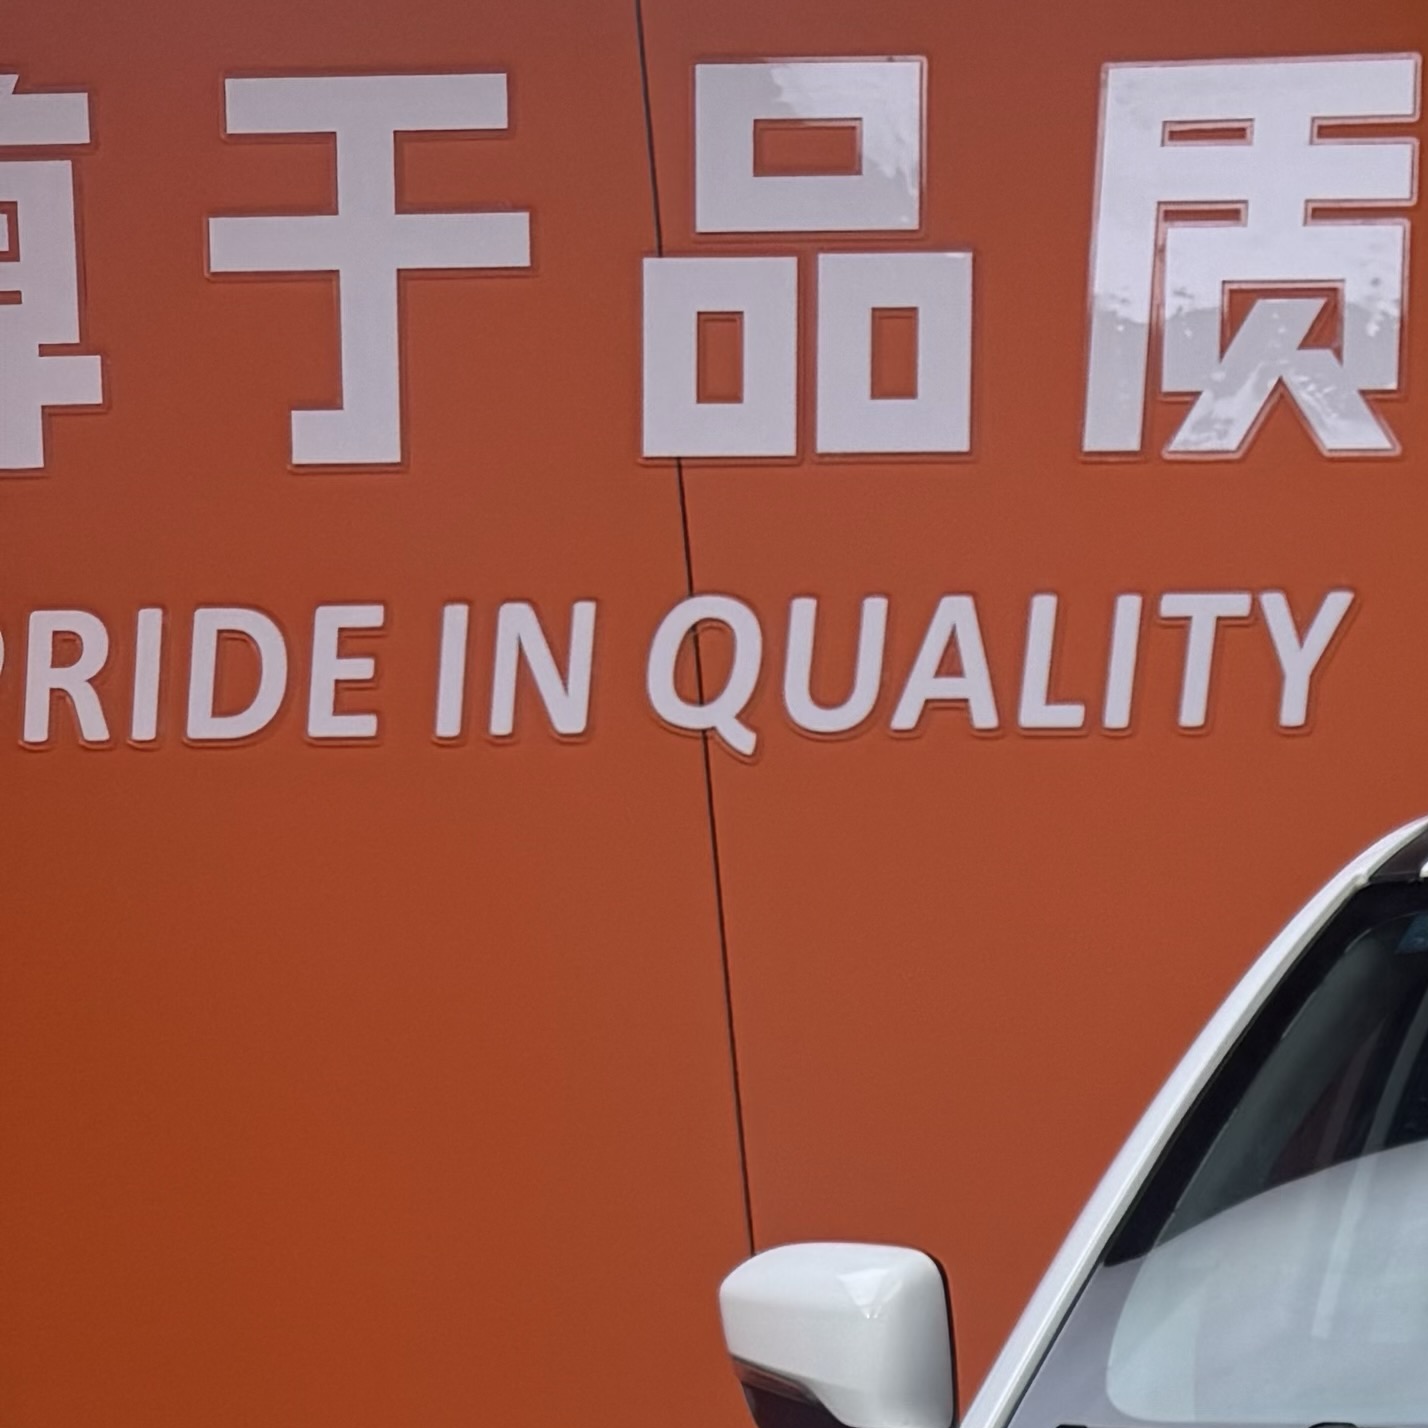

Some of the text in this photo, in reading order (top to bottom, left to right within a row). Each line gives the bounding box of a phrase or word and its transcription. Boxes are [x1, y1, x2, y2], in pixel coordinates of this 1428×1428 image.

[0, 592, 1354, 756] RIDE IN QUALITY
